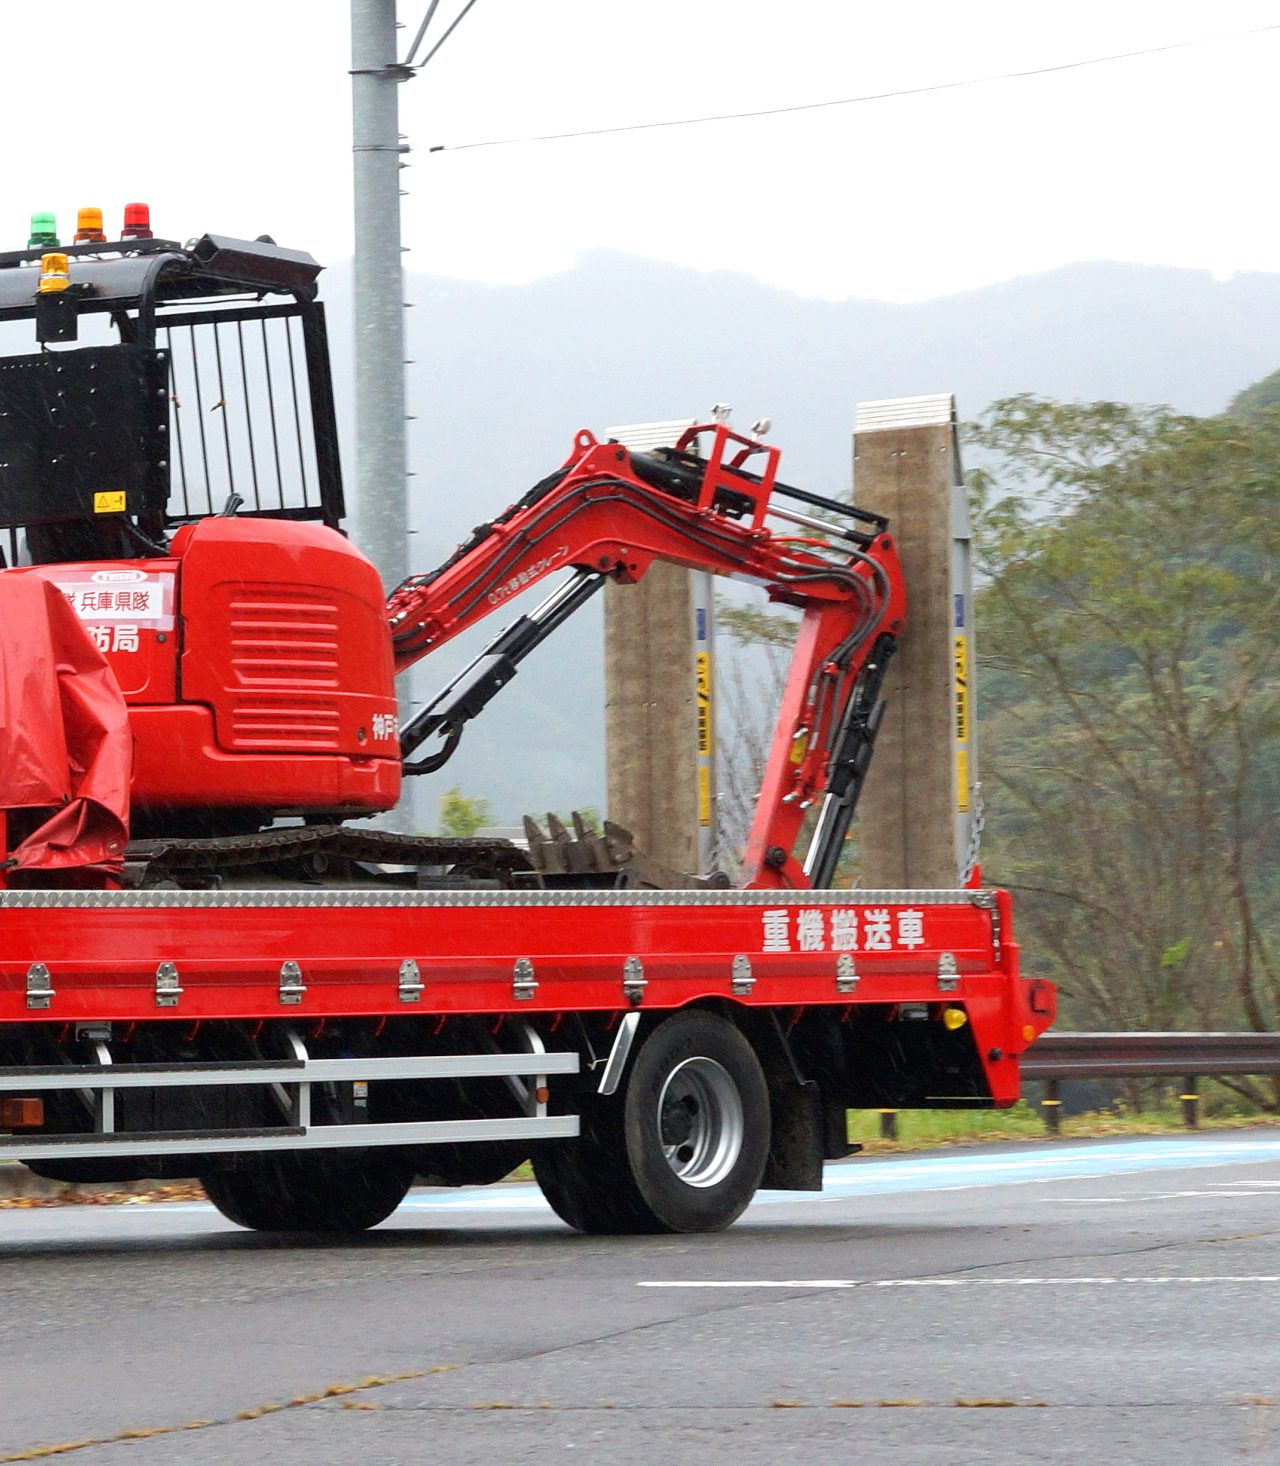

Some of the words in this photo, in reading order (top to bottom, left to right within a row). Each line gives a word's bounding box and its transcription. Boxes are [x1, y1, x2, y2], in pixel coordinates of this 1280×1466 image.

[80, 591, 150, 612] 兵庫県隊
[761, 908, 925, 952] 重機搬送車
